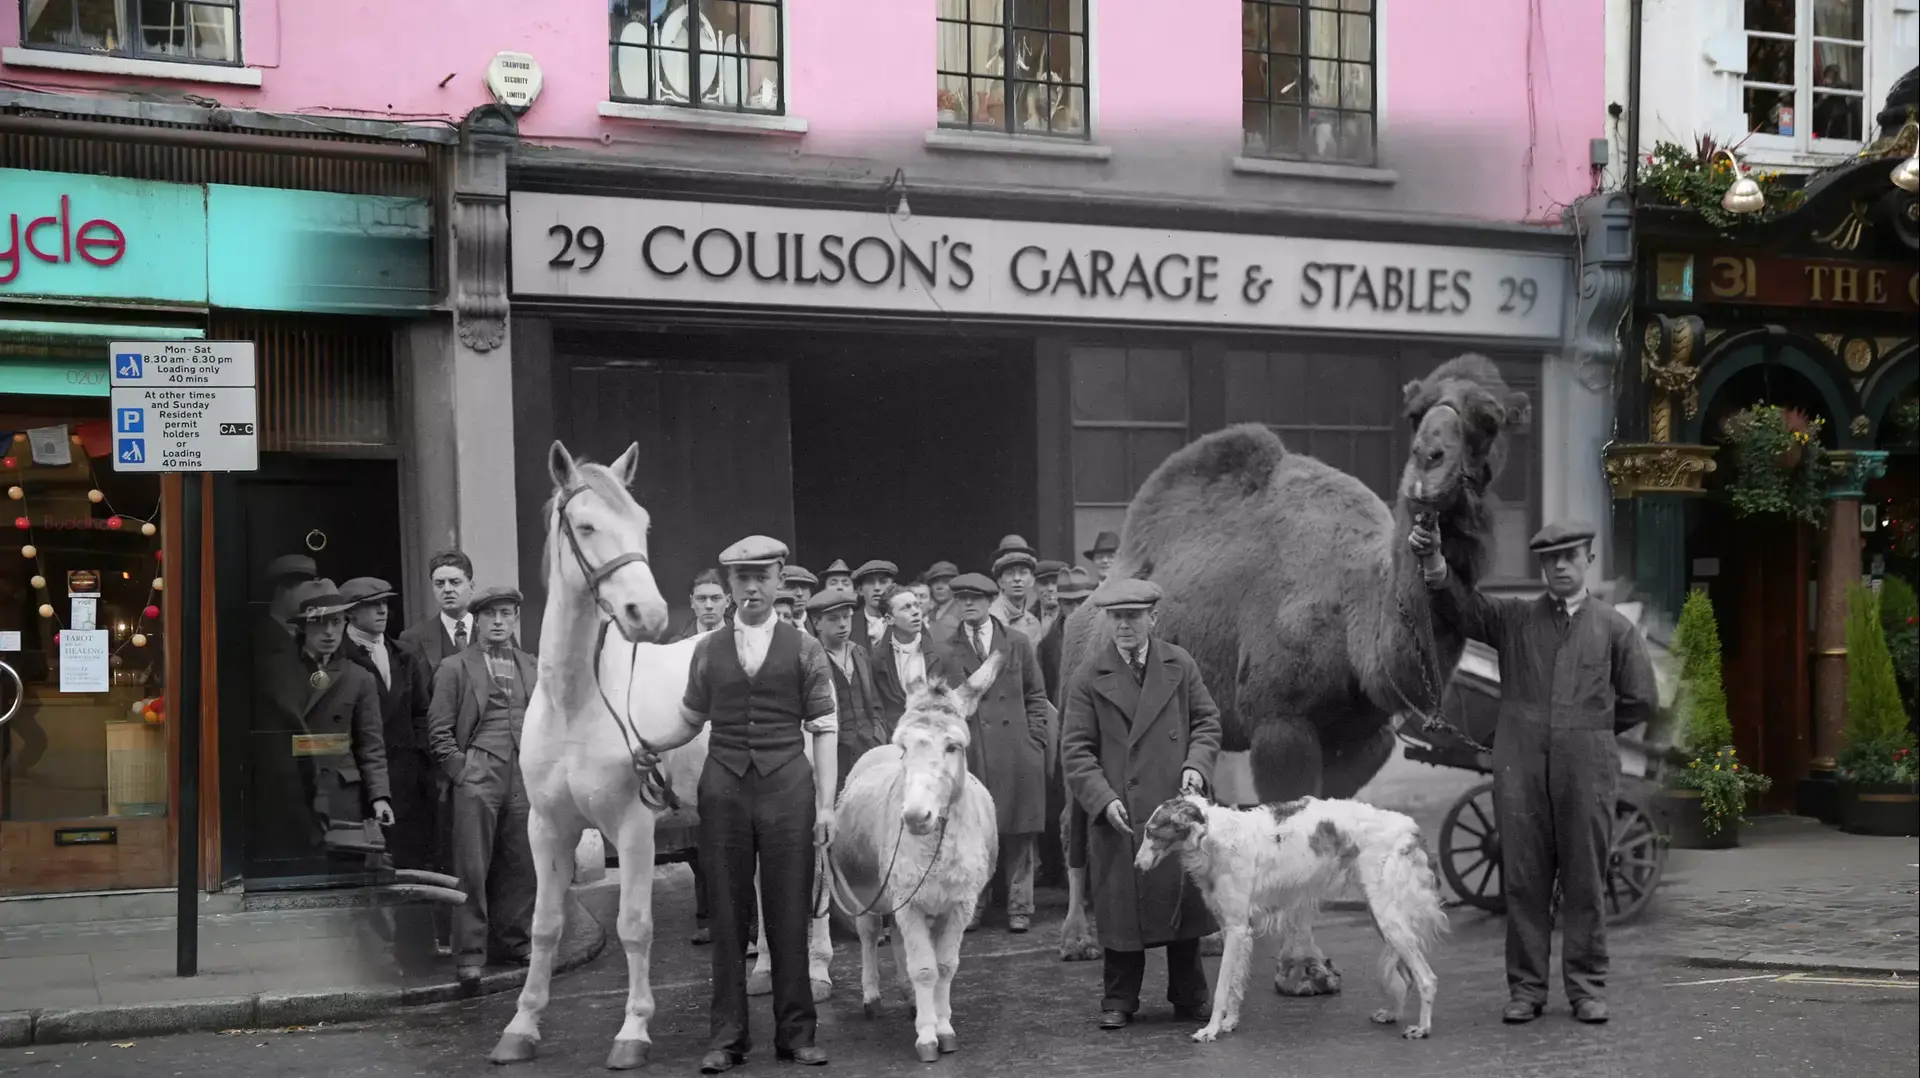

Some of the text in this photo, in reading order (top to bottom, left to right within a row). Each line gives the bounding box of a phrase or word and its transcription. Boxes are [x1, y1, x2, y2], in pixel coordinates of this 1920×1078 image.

[504, 76, 528, 84] SECURITY
[506, 91, 527, 99] LIMITED
[548, 224, 1539, 317] 29 COULSON'S GARAGE & STABLES 29
[1710, 256, 1757, 298] 31
[1804, 264, 1888, 304] THE
[165, 345, 186, 354] Mon
[194, 345, 212, 354] Sat
[143, 355, 168, 364] 8.30
[169, 356, 184, 364] am
[192, 355, 216, 364] 6.30
[217, 356, 233, 365] pm
[157, 365, 220, 374] Loading only
[168, 375, 209, 383] 40 mins
[144, 391, 216, 399] At other times
[151, 401, 210, 410] and Sunday
[159, 410, 203, 419] Resident
[123, 410, 140, 431] P
[164, 420, 197, 429] permit
[163, 430, 200, 438] holders
[162, 450, 201, 458] Loading
[162, 459, 202, 467] 40 mins
[65, 634, 94, 642] TAROT
[65, 647, 104, 655] HEALING
